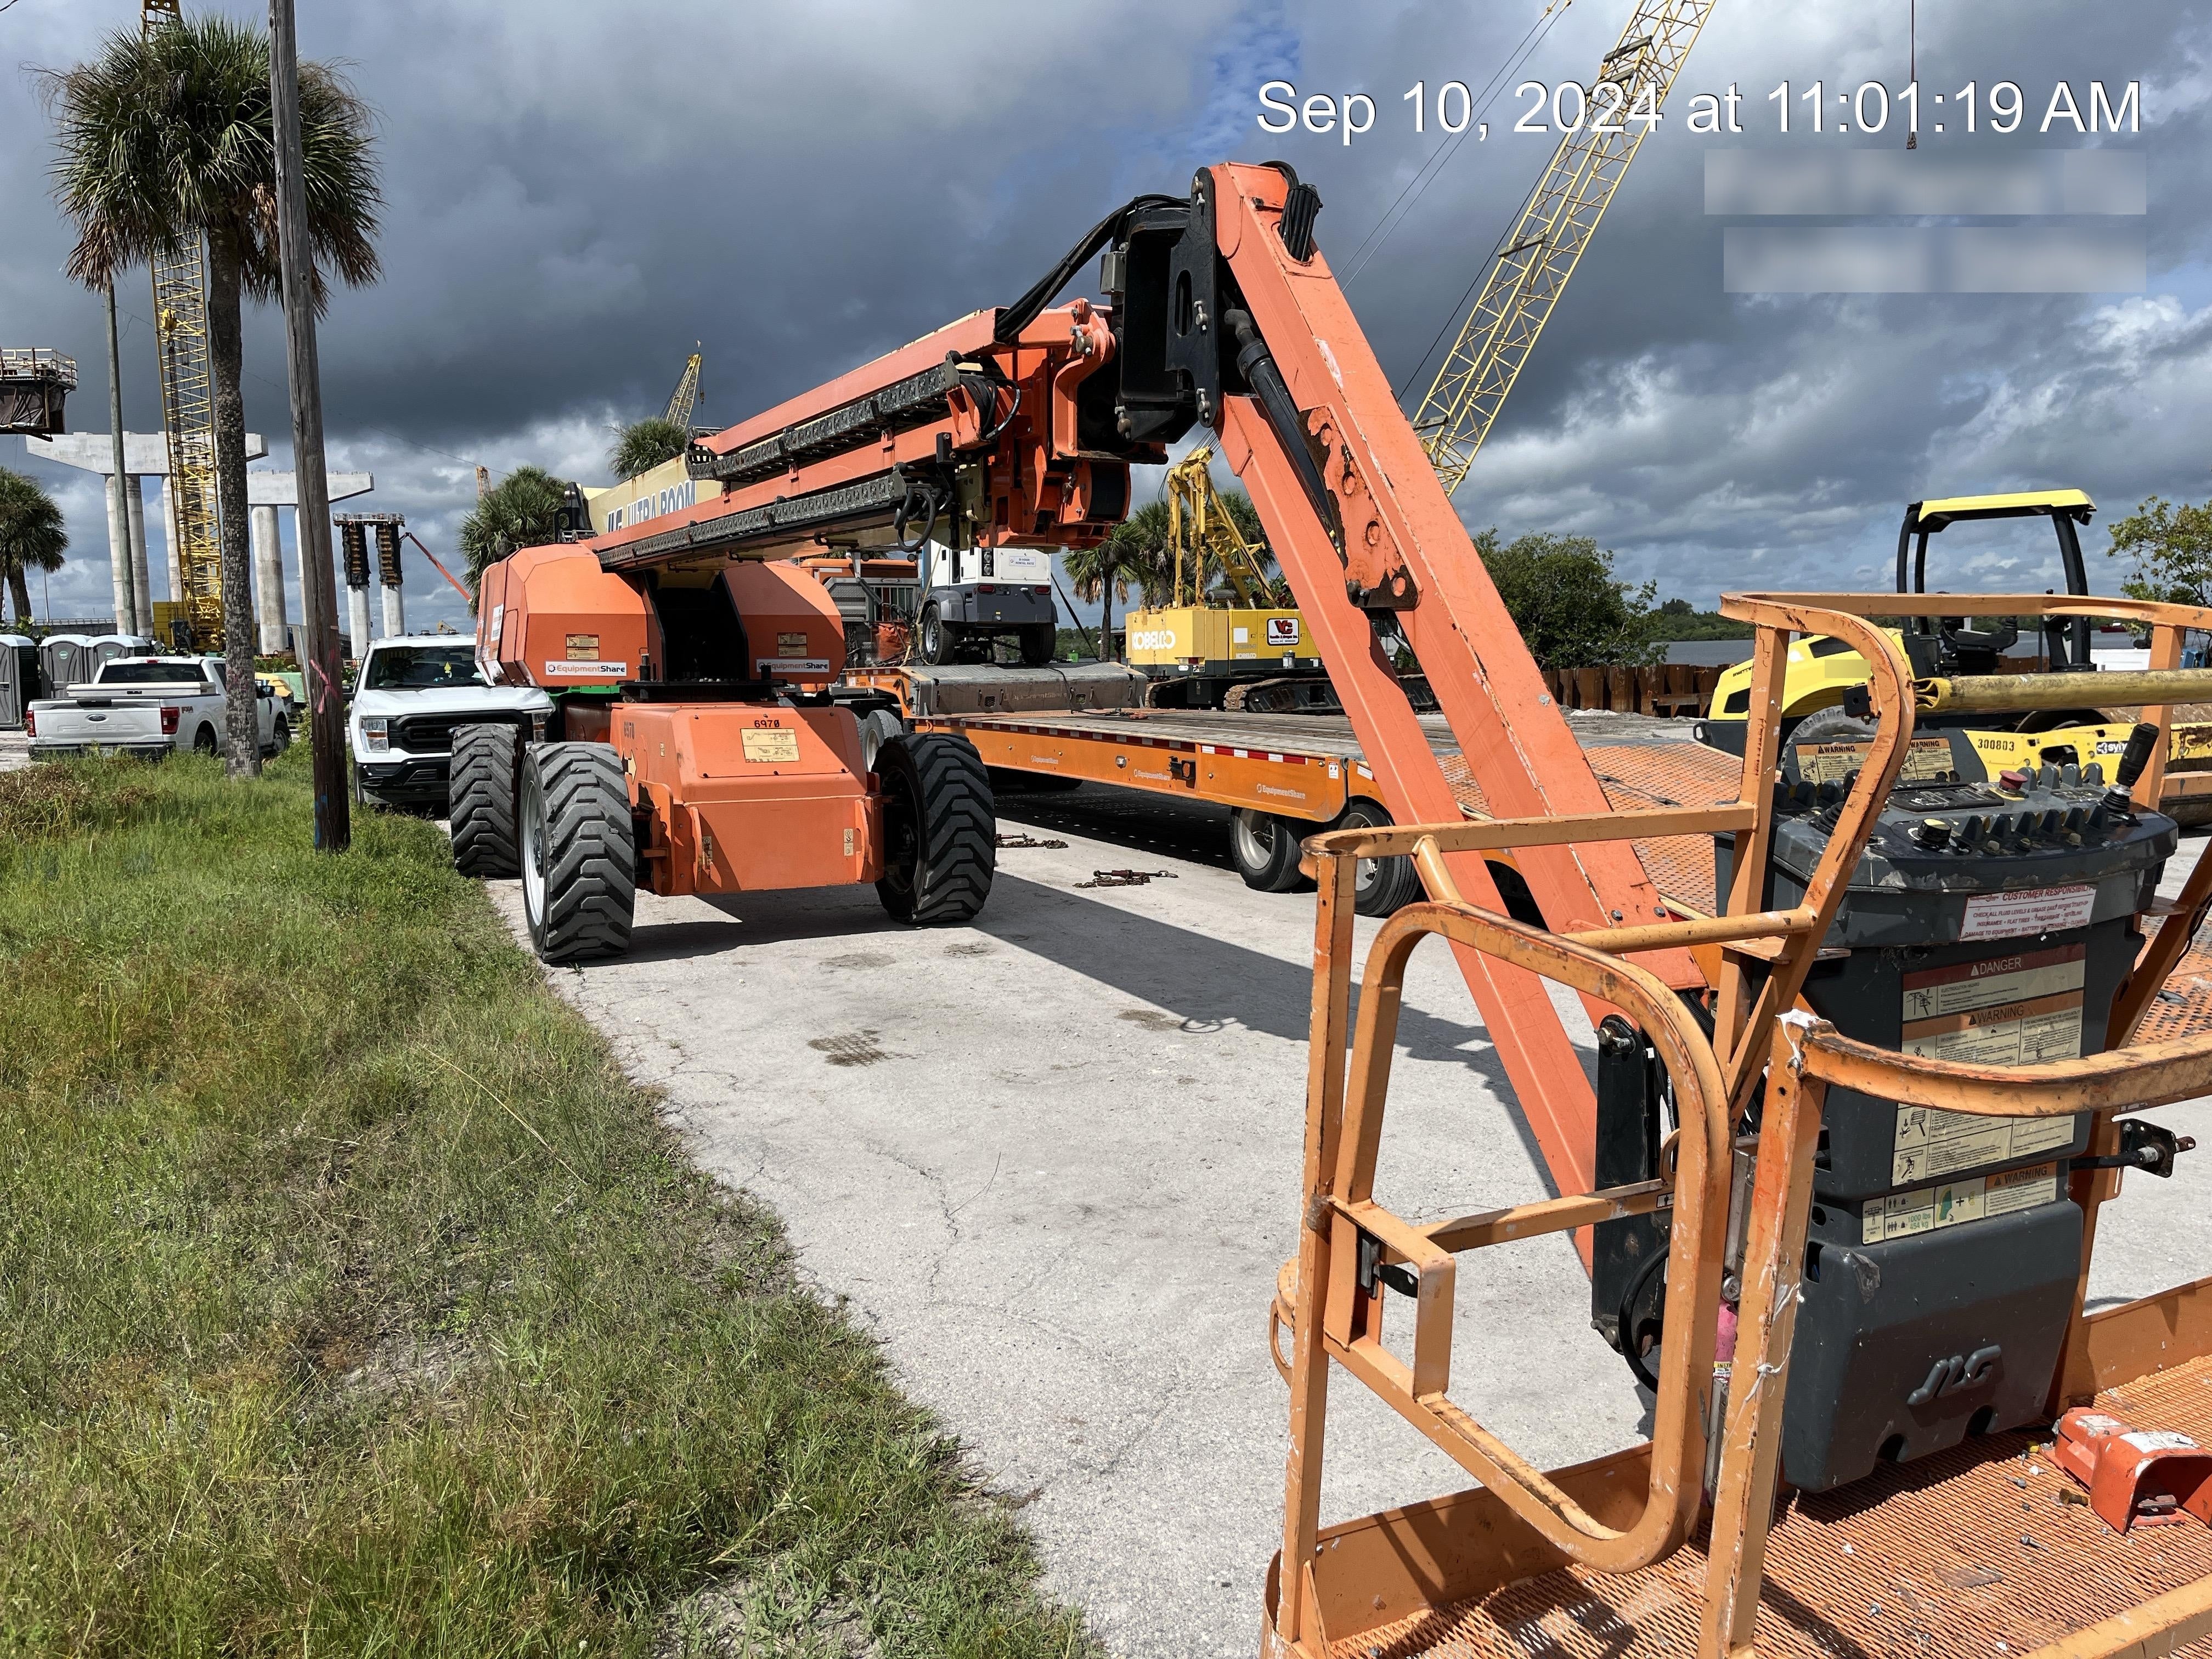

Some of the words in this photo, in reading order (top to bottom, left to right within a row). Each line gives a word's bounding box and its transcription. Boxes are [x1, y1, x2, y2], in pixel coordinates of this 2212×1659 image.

[660, 480, 696, 515] BOOM
[1274, 620, 1293, 635] VC
[1131, 630, 1176, 650] KOBELCO
[556, 664, 625, 673] EquipmentShare
[754, 719, 780, 728] 6970
[1824, 744, 1856, 753] WARNING
[1910, 740, 1940, 749] WARNING
[1977, 738, 2015, 752] 300803
[2107, 741, 2128, 754] sylv
[1262, 785, 1306, 799] EquipmentShare
[2002, 890, 2044, 901] CUSTOMER
[2045, 885, 2091, 898] RESPONSIBILIT
[1979, 957, 2023, 975] DANGER
[1977, 1005, 2024, 1024] WARNING
[2004, 1166, 2048, 1184] WARNING
[1908, 1214, 1921, 1222] 1000
[1922, 1212, 1932, 1221] lbs
[1909, 1222, 1921, 1230] 454
[1921, 1221, 1929, 1229] kg
[1906, 1344, 2002, 1406] JLG
